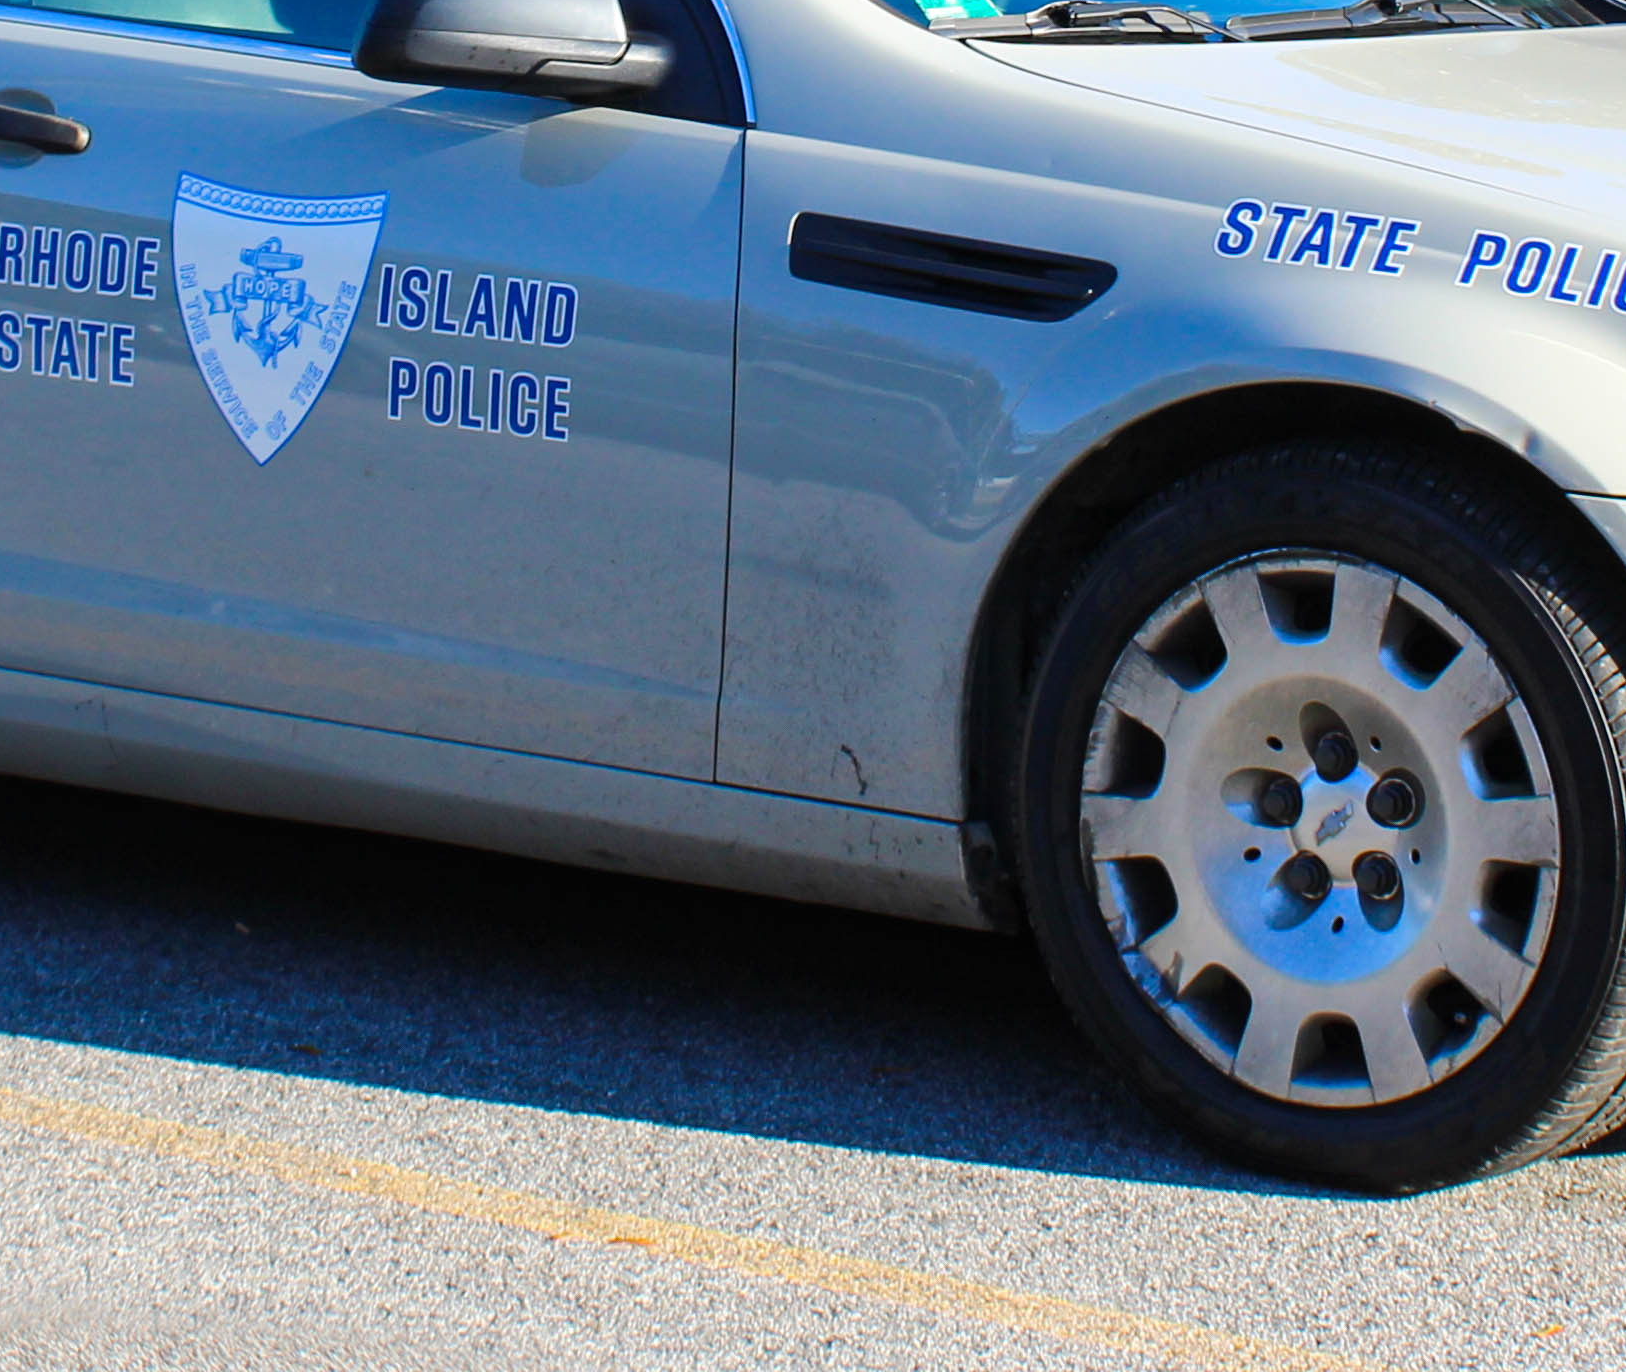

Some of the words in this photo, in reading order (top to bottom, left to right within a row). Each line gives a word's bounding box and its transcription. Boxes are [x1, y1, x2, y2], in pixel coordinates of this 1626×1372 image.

[1214, 197, 1421, 277] STATE
[180, 263, 198, 290] IN
[243, 276, 292, 299] HOPE
[376, 264, 579, 348] ISLAND
[185, 294, 211, 346] THE
[319, 280, 358, 354] STATE
[201, 348, 259, 440] SERVICE
[289, 361, 324, 406] THE
[387, 356, 571, 442] POLICE
[264, 409, 288, 441] OF
